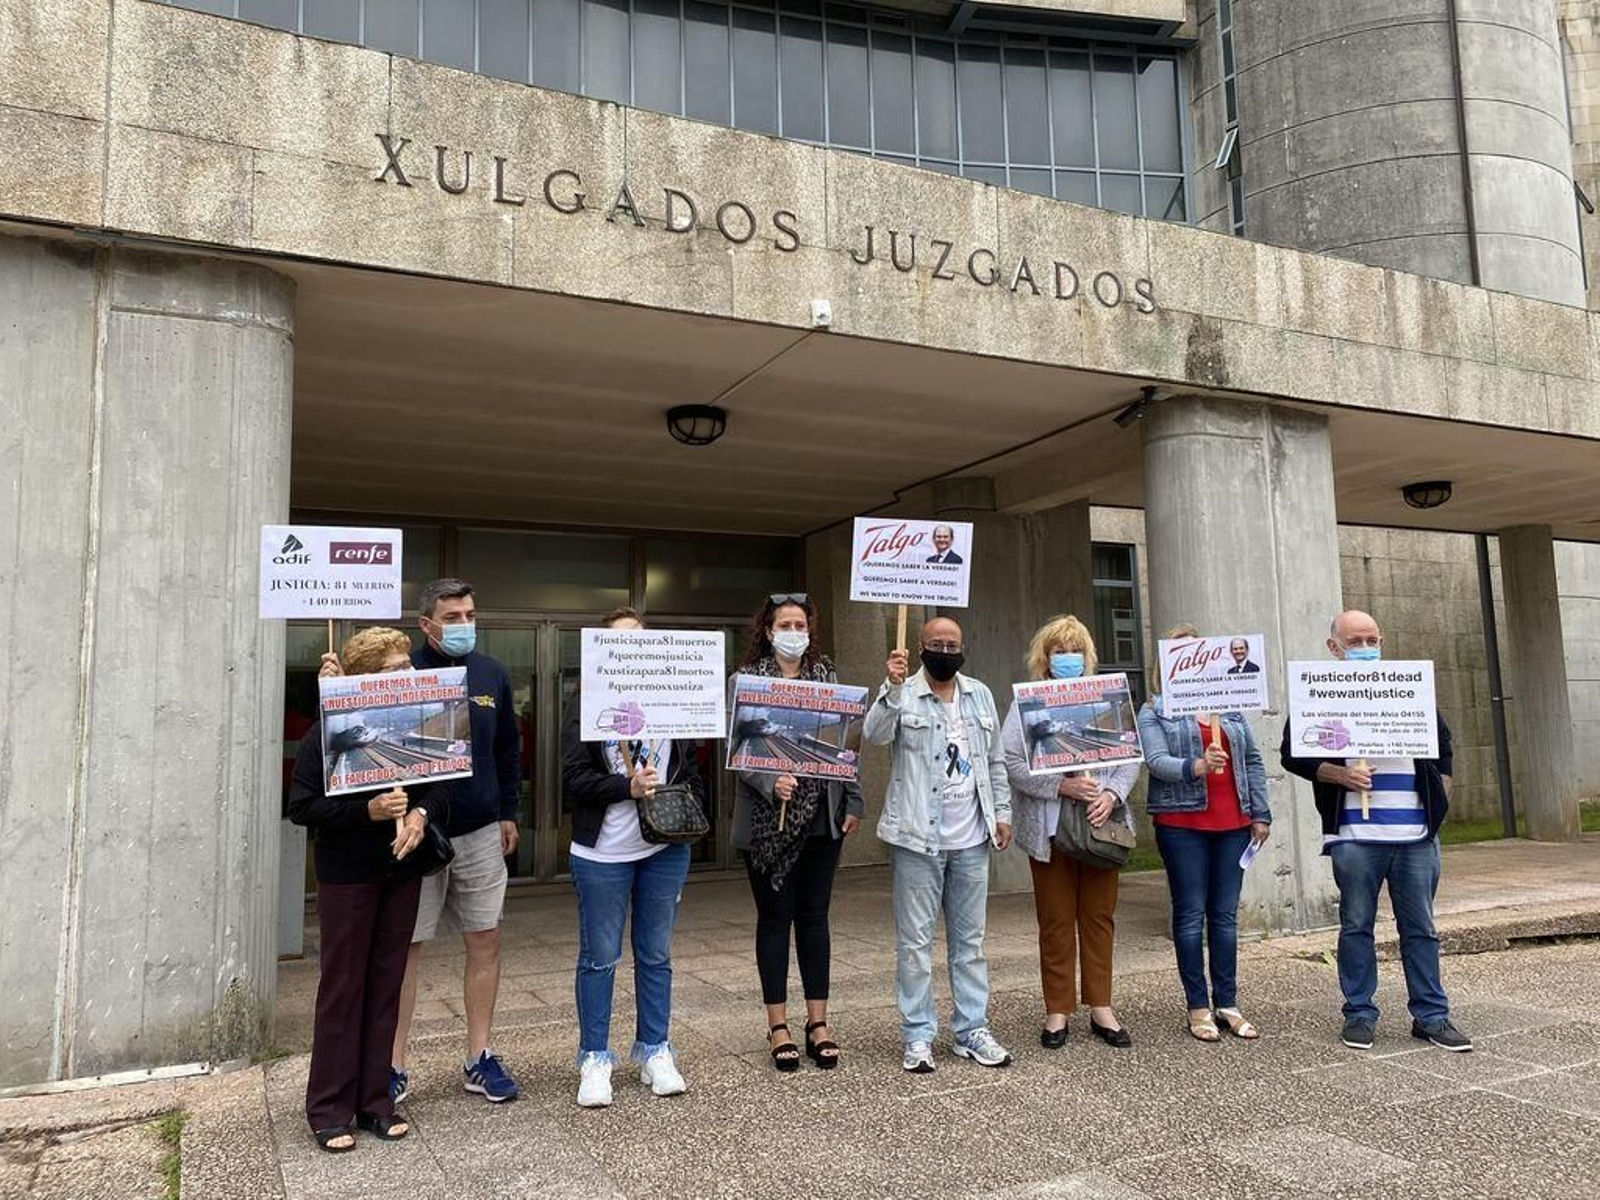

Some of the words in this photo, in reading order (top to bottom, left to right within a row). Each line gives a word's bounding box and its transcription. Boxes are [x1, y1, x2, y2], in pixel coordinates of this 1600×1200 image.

[374, 131, 800, 252] XULGADOS
[851, 225, 1156, 315] JUZGADOS
[862, 522, 928, 562] Talgo
[272, 553, 312, 565] adif
[335, 544, 388, 565] renfe
[270, 579, 331, 591] JUSTICIA:
[334, 580, 347, 590] 81
[352, 581, 395, 590] MUERTOS
[330, 597, 373, 606] HERIDOS
[593, 633, 717, 647] #justiciapara81muertos
[608, 650, 704, 662] #queremosjusticia
[1168, 639, 1226, 681] Talgo
[596, 665, 715, 678] #xustizapara81mortos
[1300, 671, 1423, 684] #justicefor81dead
[360, 677, 412, 692] QUEREMOS
[1207, 675, 1224, 683] SABER
[608, 681, 704, 694] #queremosxustiza
[770, 683, 815, 696] QUEREMOS
[818, 686, 834, 697] UNA
[1018, 687, 1031, 697] WE
[1032, 685, 1053, 697] WANT
[1308, 687, 1415, 700] #wewantjustice
[820, 763, 854, 776] HERIDOS
[330, 775, 342, 789] 81
